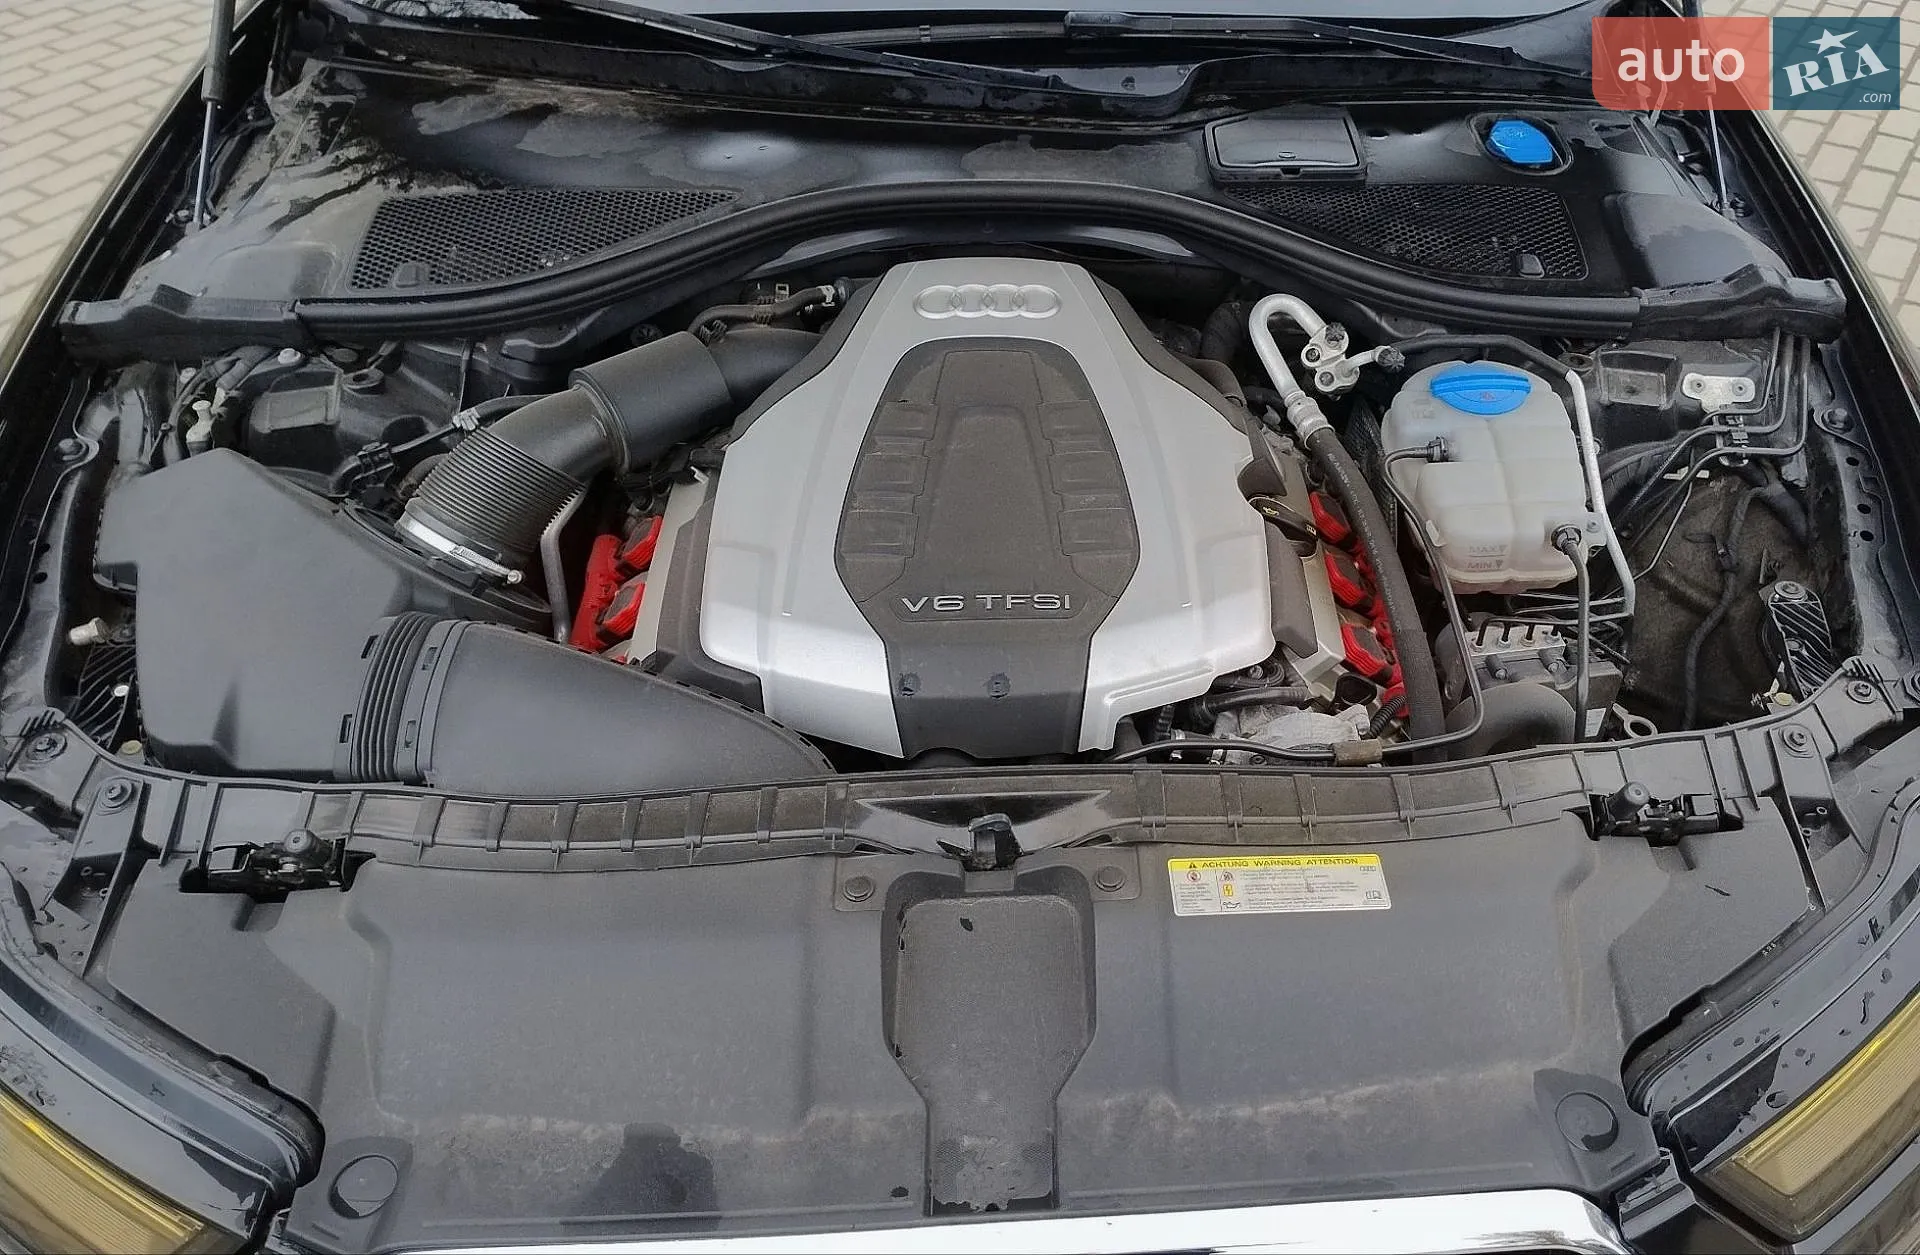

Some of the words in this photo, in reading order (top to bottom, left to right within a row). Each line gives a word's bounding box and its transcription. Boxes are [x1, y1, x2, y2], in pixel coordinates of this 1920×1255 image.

[1468, 545, 1498, 553] MAX
[1466, 560, 1492, 569] MIN
[901, 595, 964, 612] V6
[975, 594, 1071, 610] TFSI
[1201, 861, 1249, 869] ACHTUNG
[1253, 859, 1301, 867] WARNING
[1306, 857, 1358, 866] ATTENTION
